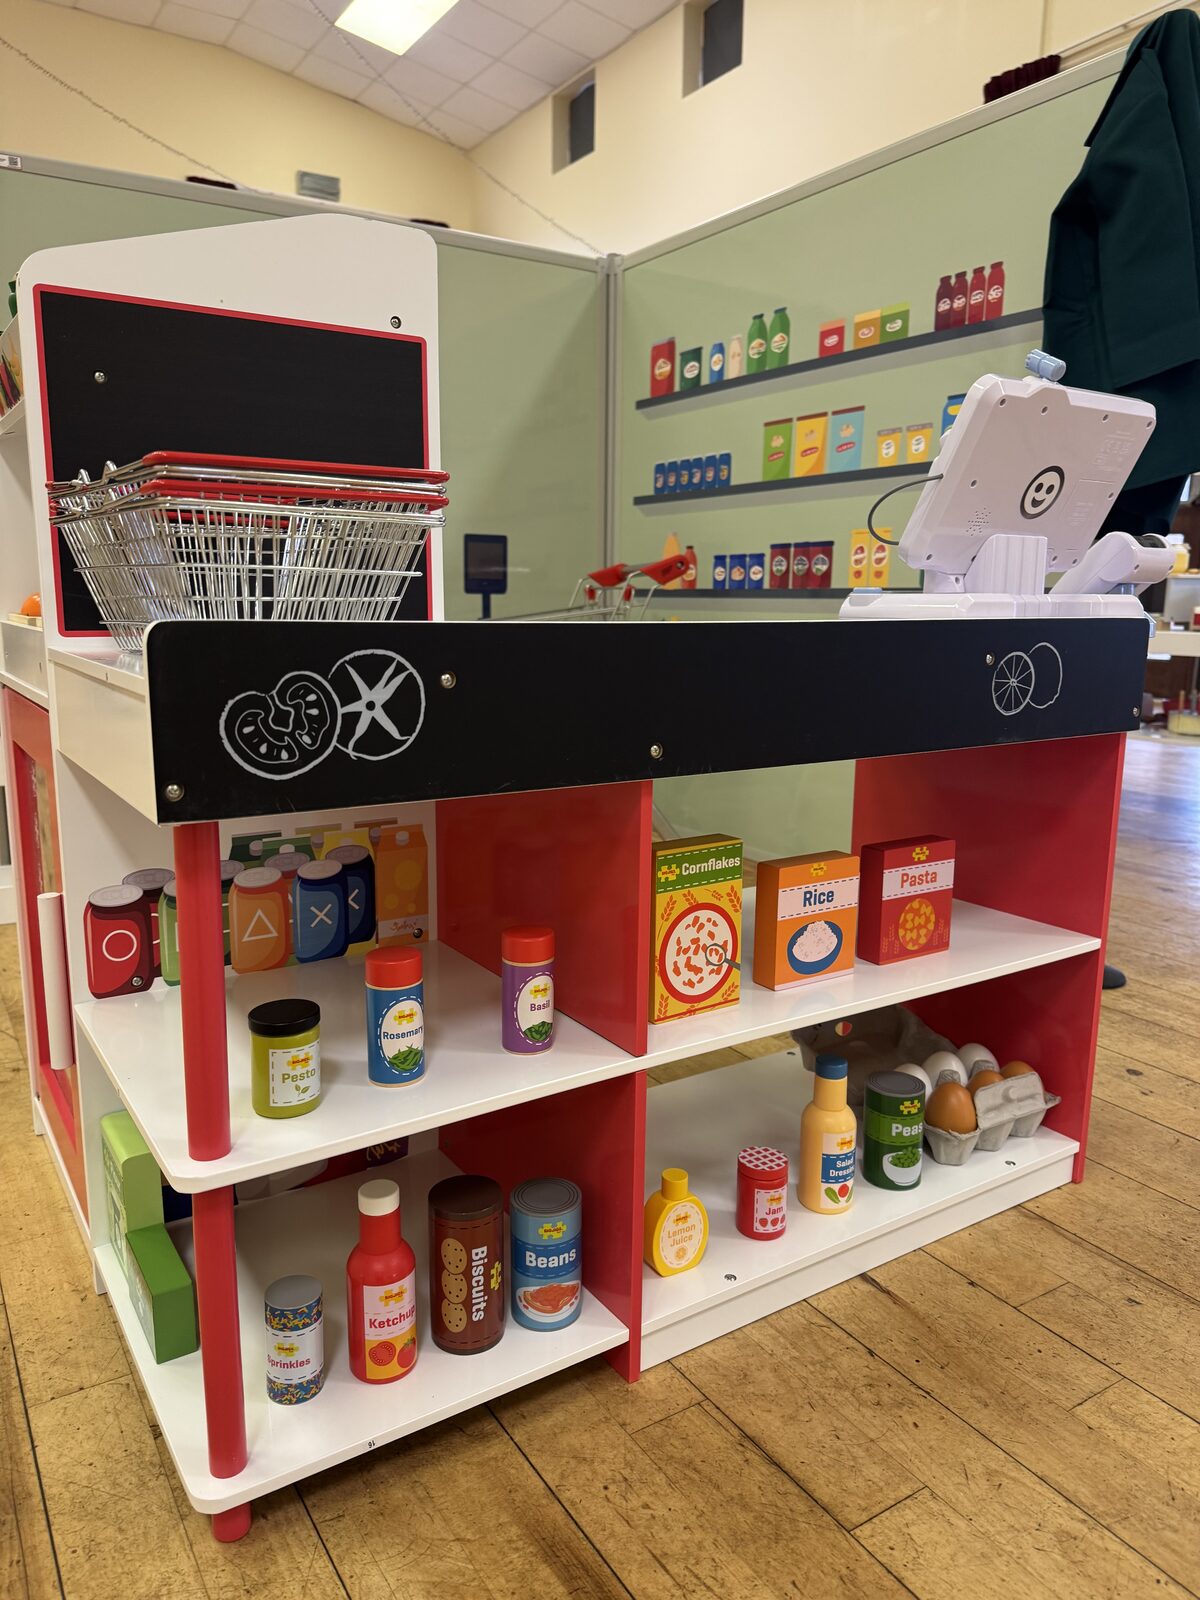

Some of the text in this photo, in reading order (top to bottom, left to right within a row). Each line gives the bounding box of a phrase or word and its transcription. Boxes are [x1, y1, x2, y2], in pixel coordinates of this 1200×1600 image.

[682, 856, 741, 876] Cornflakes
[900, 870, 938, 889] Pasta
[803, 888, 835, 908] Rice
[281, 1068, 316, 1084] Pesto
[891, 1122, 924, 1137] Peas
[765, 1206, 784, 1216] Jam
[667, 1223, 696, 1239] Lemon
[670, 1233, 693, 1247] Juice
[525, 1248, 577, 1268] Beans
[471, 1245, 488, 1322] Biscuits
